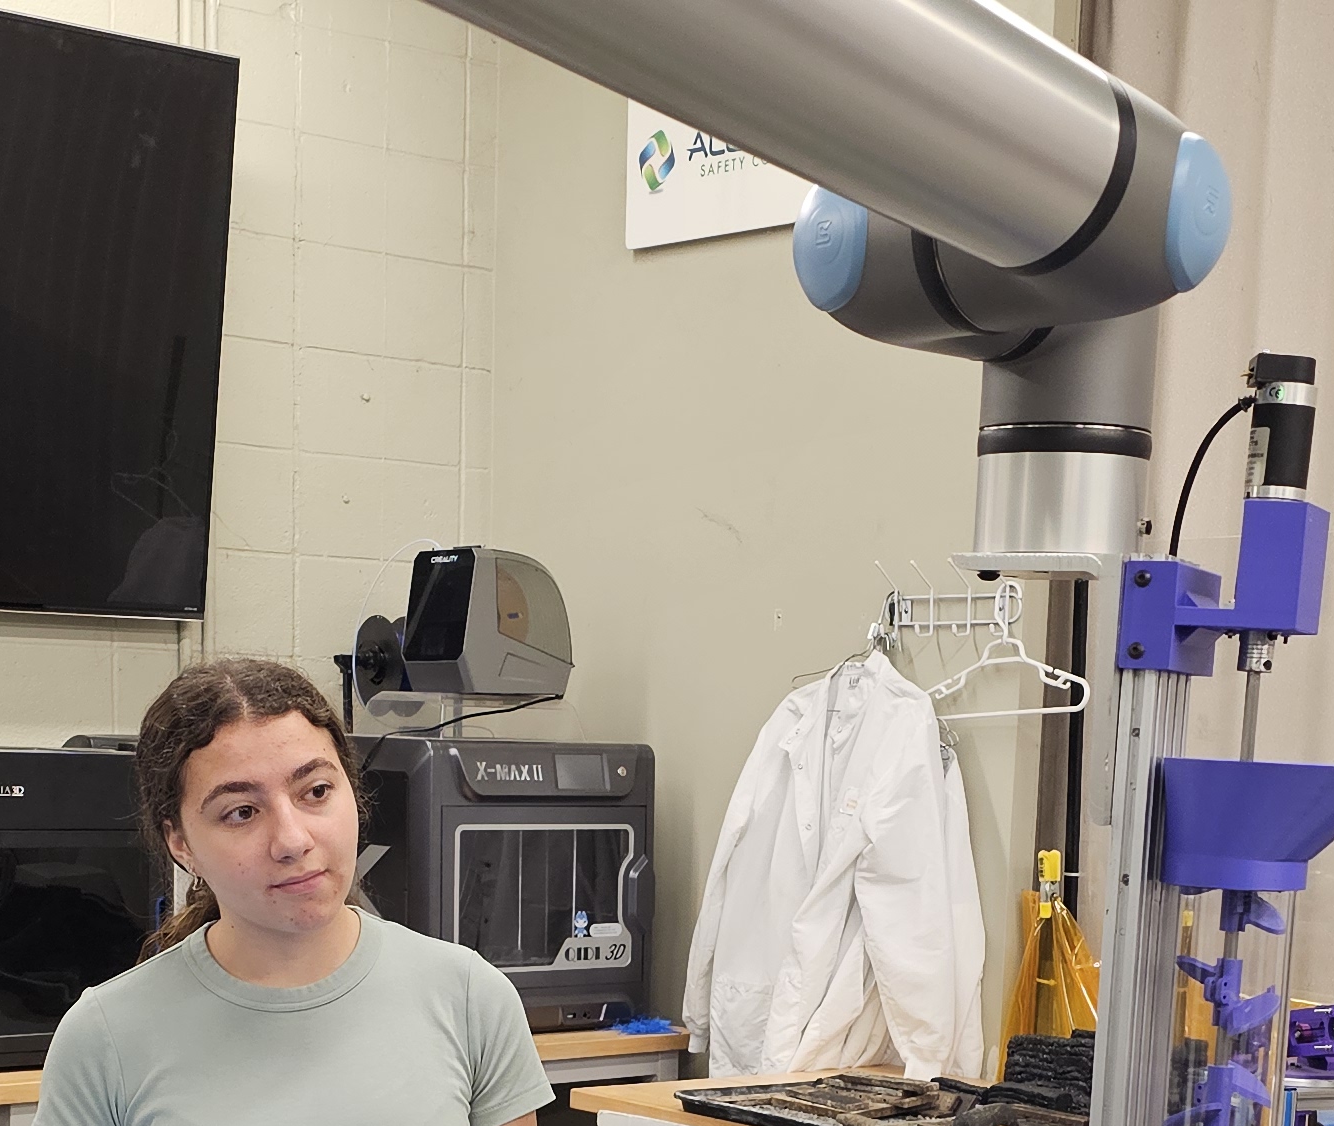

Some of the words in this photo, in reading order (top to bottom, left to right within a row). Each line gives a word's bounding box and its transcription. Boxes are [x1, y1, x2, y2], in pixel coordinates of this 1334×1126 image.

[700, 156, 745, 177] SAFETY
[475, 761, 531, 782] X-MAX
[564, 946, 601, 962] QIDI
[605, 943, 627, 961] 3D
